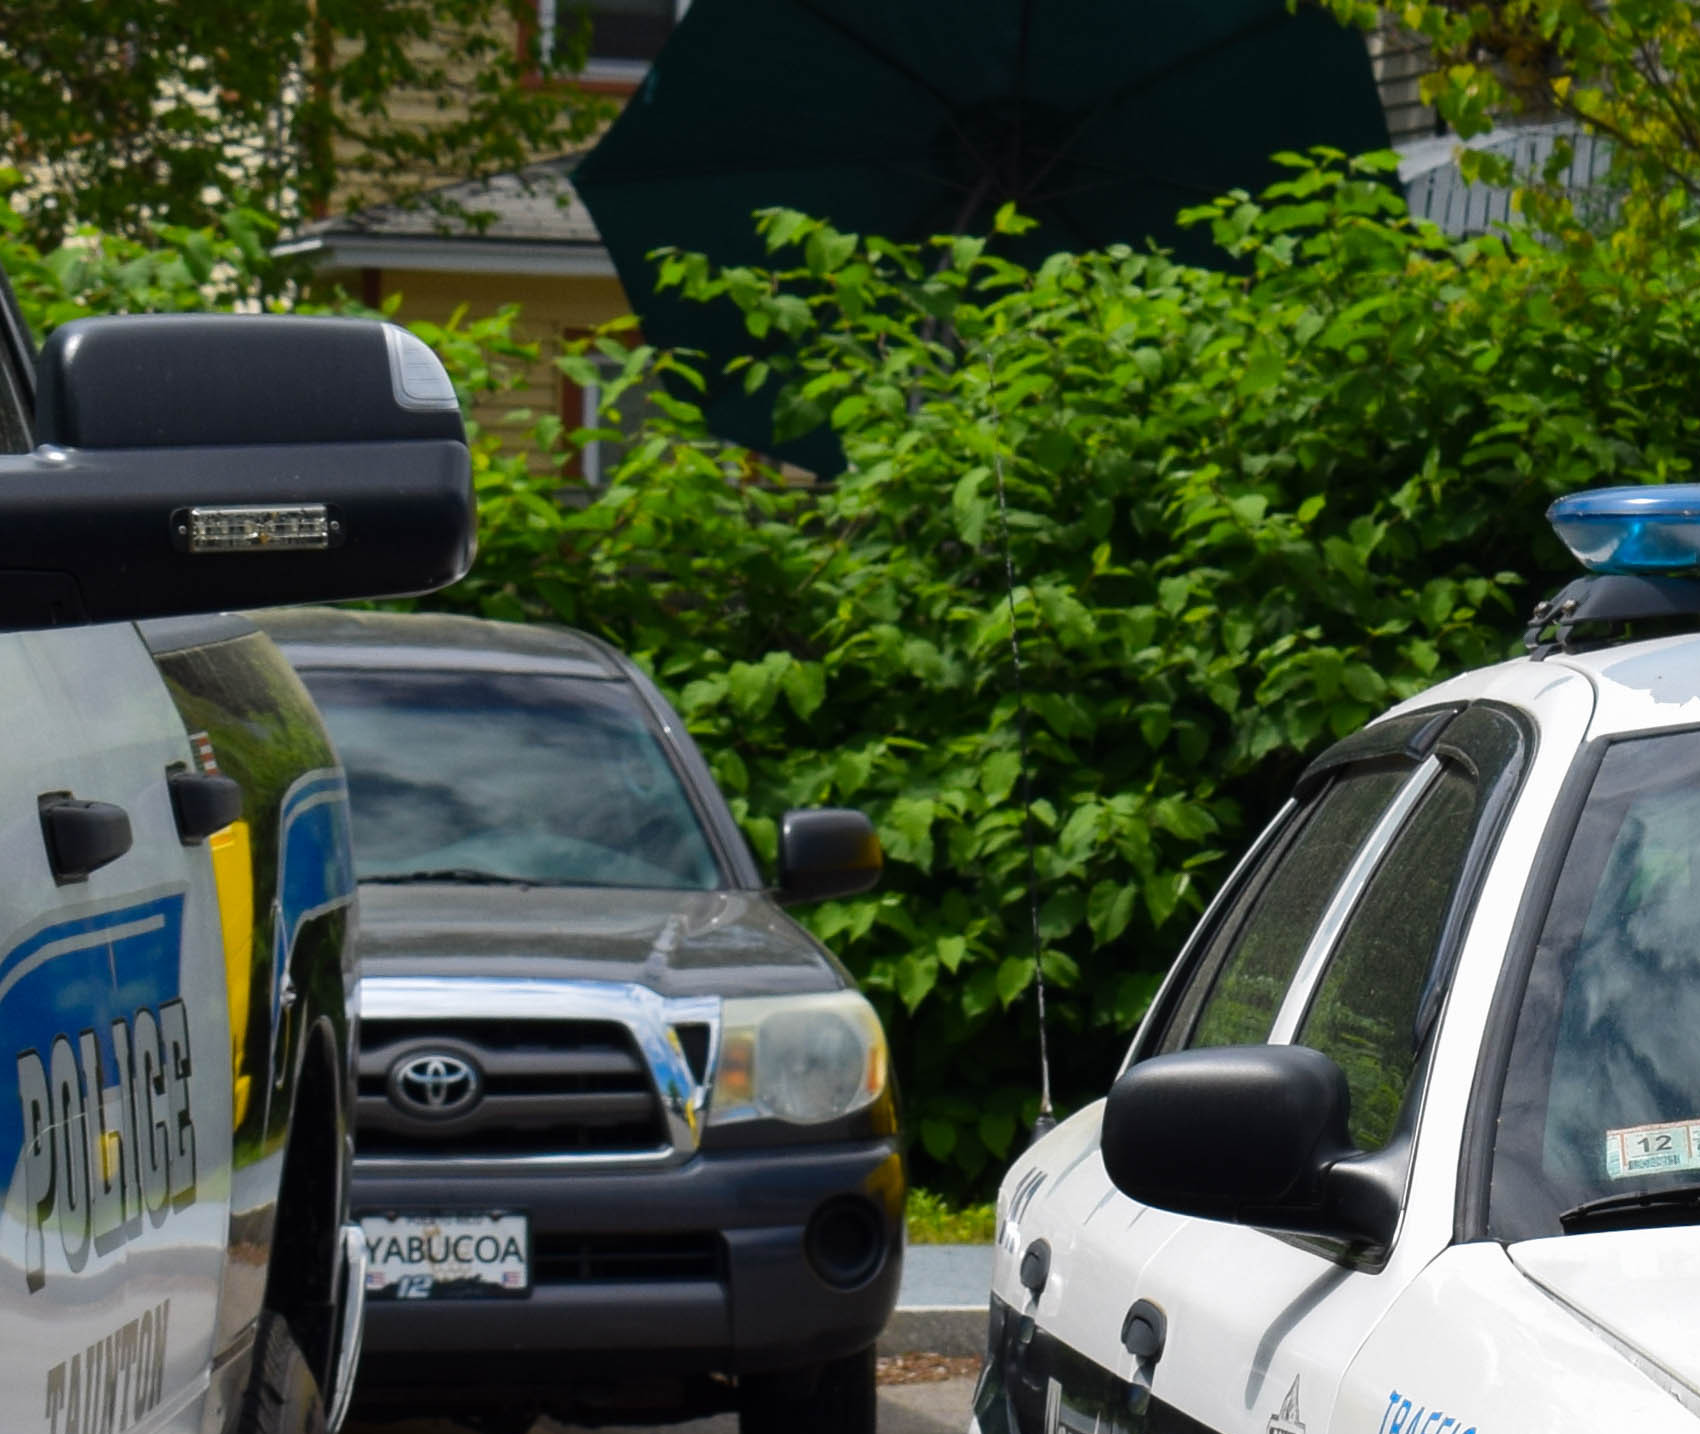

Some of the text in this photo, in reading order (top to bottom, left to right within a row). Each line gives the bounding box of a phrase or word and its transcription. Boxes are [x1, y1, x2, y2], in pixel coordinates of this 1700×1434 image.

[16, 997, 197, 1295] POLICE
[1637, 1134, 1673, 1153] 12
[365, 1235, 525, 1264] YABUCOA
